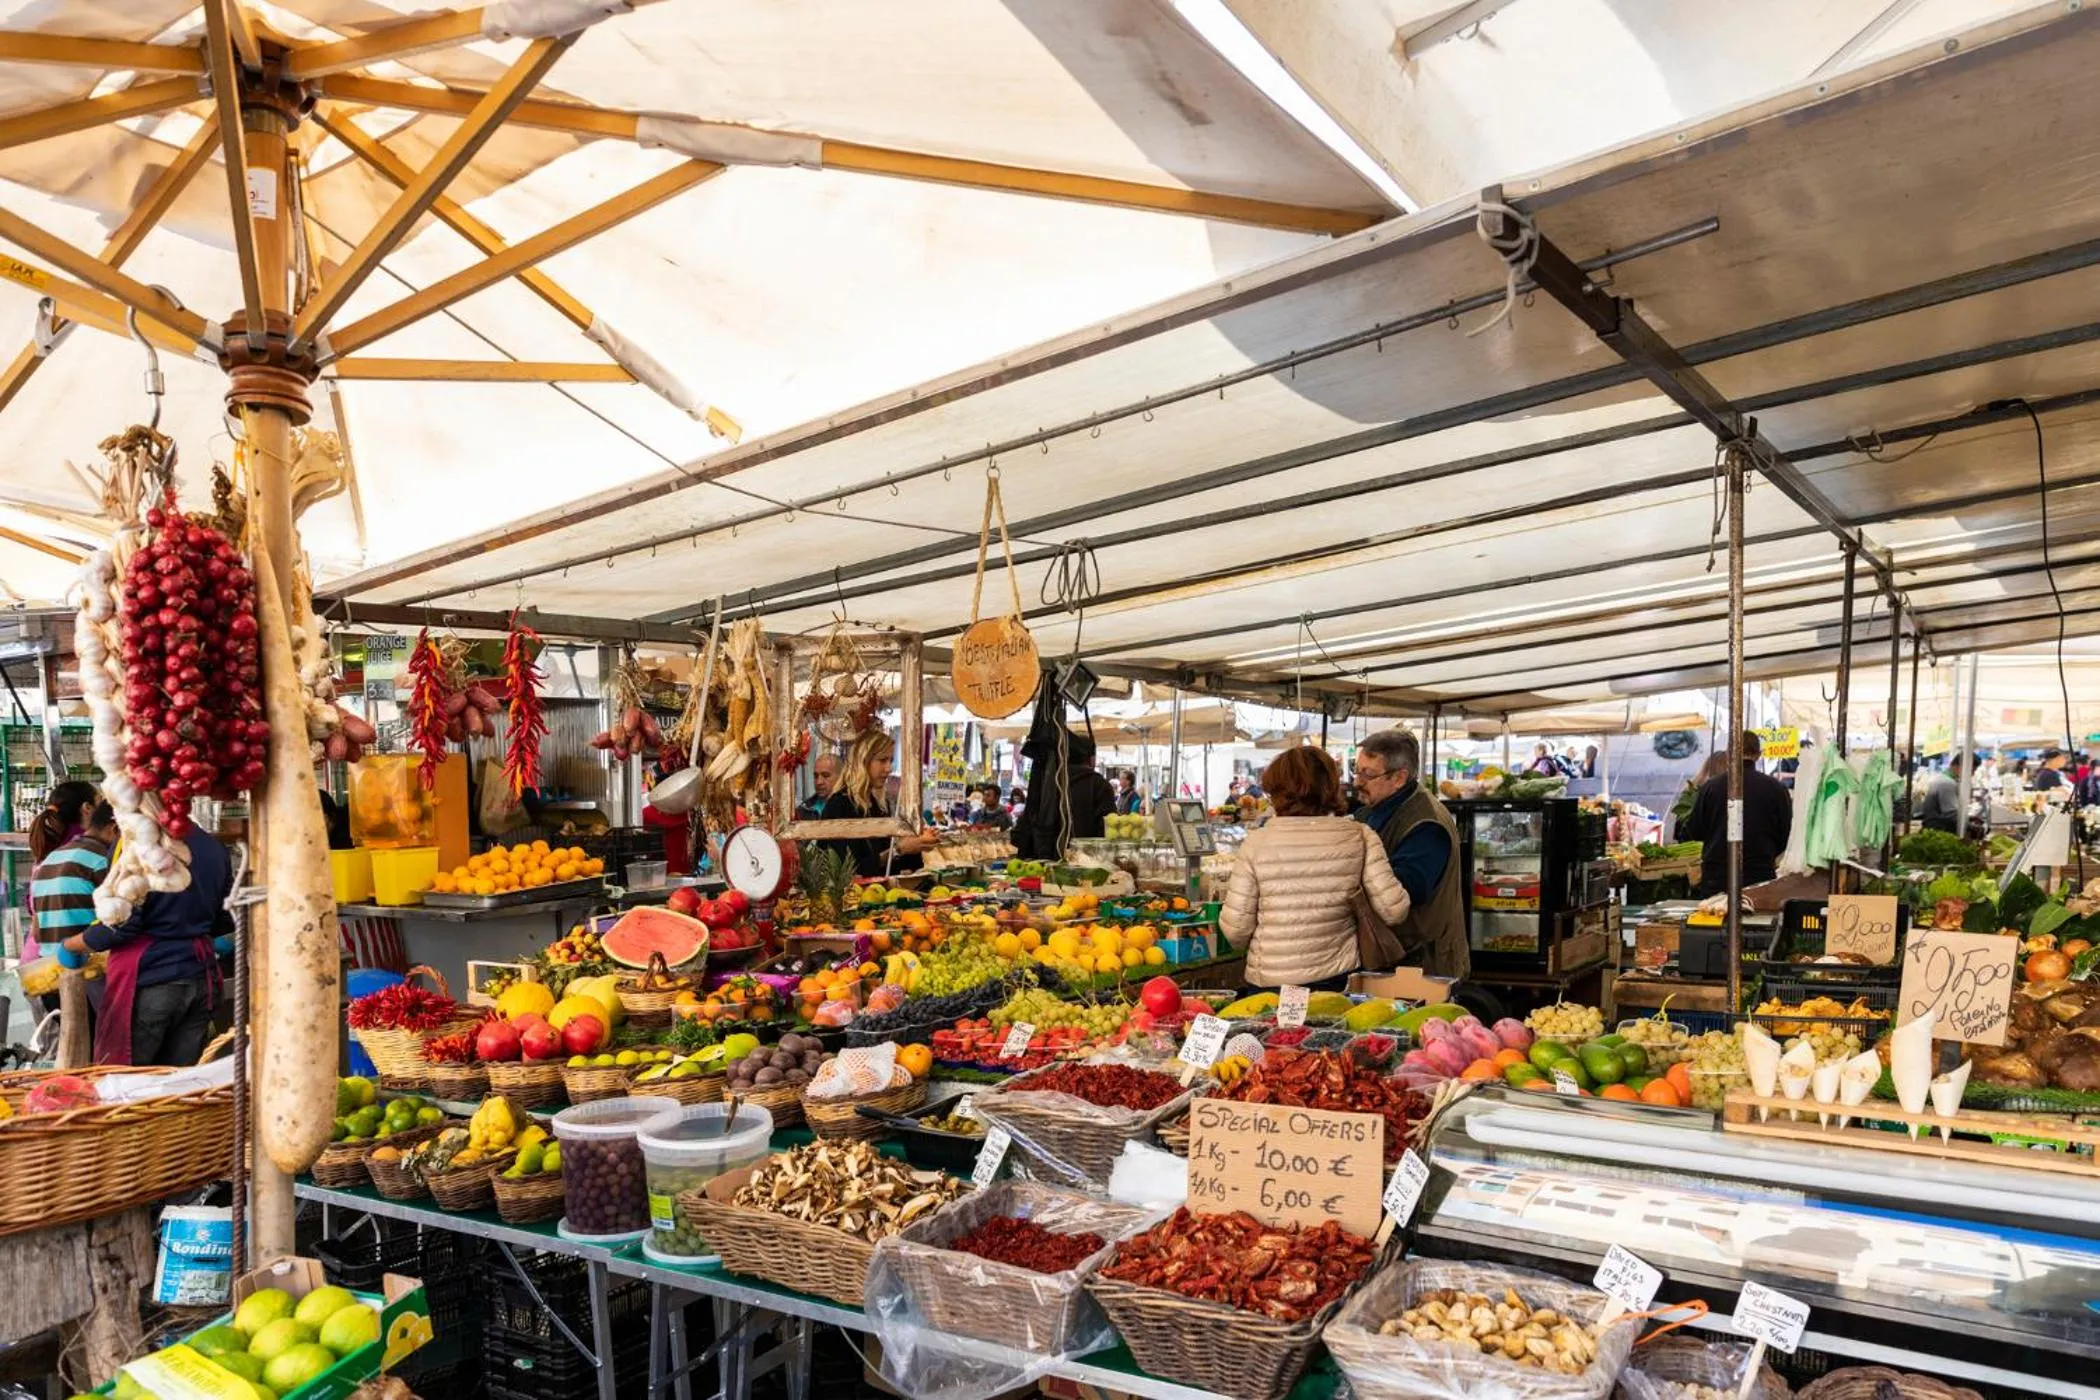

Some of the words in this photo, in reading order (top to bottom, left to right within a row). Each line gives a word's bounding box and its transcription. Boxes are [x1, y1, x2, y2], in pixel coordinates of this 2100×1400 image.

[366, 636, 406, 649] ORANGE
[366, 650, 393, 665] JUICE
[968, 675, 1016, 705] TRUFFLE
[1197, 1102, 1281, 1134] SPECIAL
[1259, 1177, 1313, 1212] 6,00
